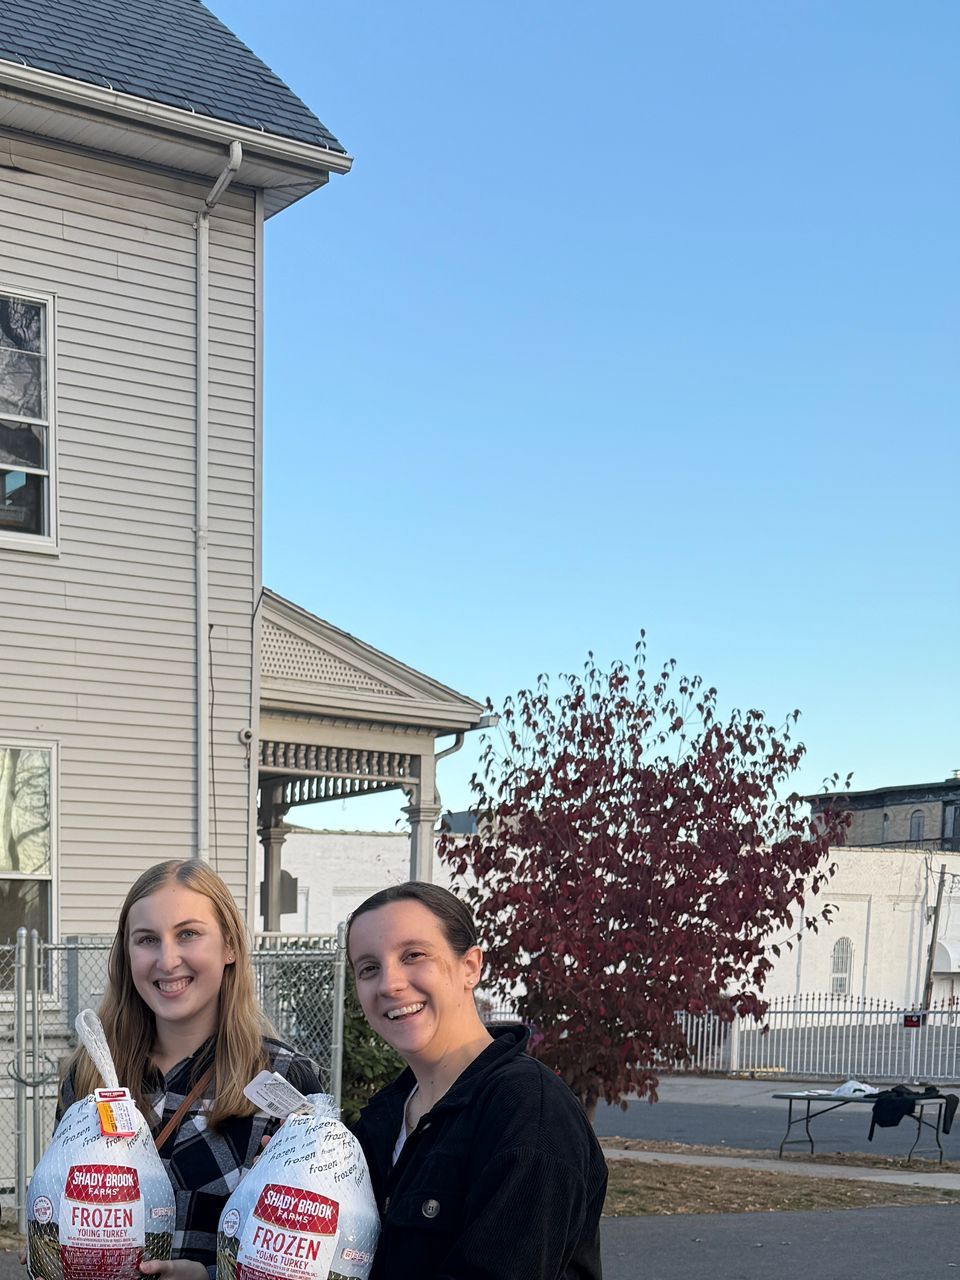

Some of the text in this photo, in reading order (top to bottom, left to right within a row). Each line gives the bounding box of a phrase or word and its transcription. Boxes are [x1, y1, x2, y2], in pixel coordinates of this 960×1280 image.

[62, 1126, 91, 1147] frozen
[82, 1133, 103, 1147] froz
[284, 1151, 316, 1167] frozen
[309, 1160, 338, 1174] frozen
[72, 1171, 134, 1187] SHADY BROOK
[334, 1163, 357, 1183] frozen
[264, 1190, 334, 1219] SHADY BROOK
[71, 1207, 133, 1228] FROZEN
[77, 1228, 128, 1238] YOUNG TURKEY
[252, 1225, 321, 1261] FROZEN
[256, 1249, 278, 1264] YOUNG
[281, 1256, 309, 1271] TURKEY
